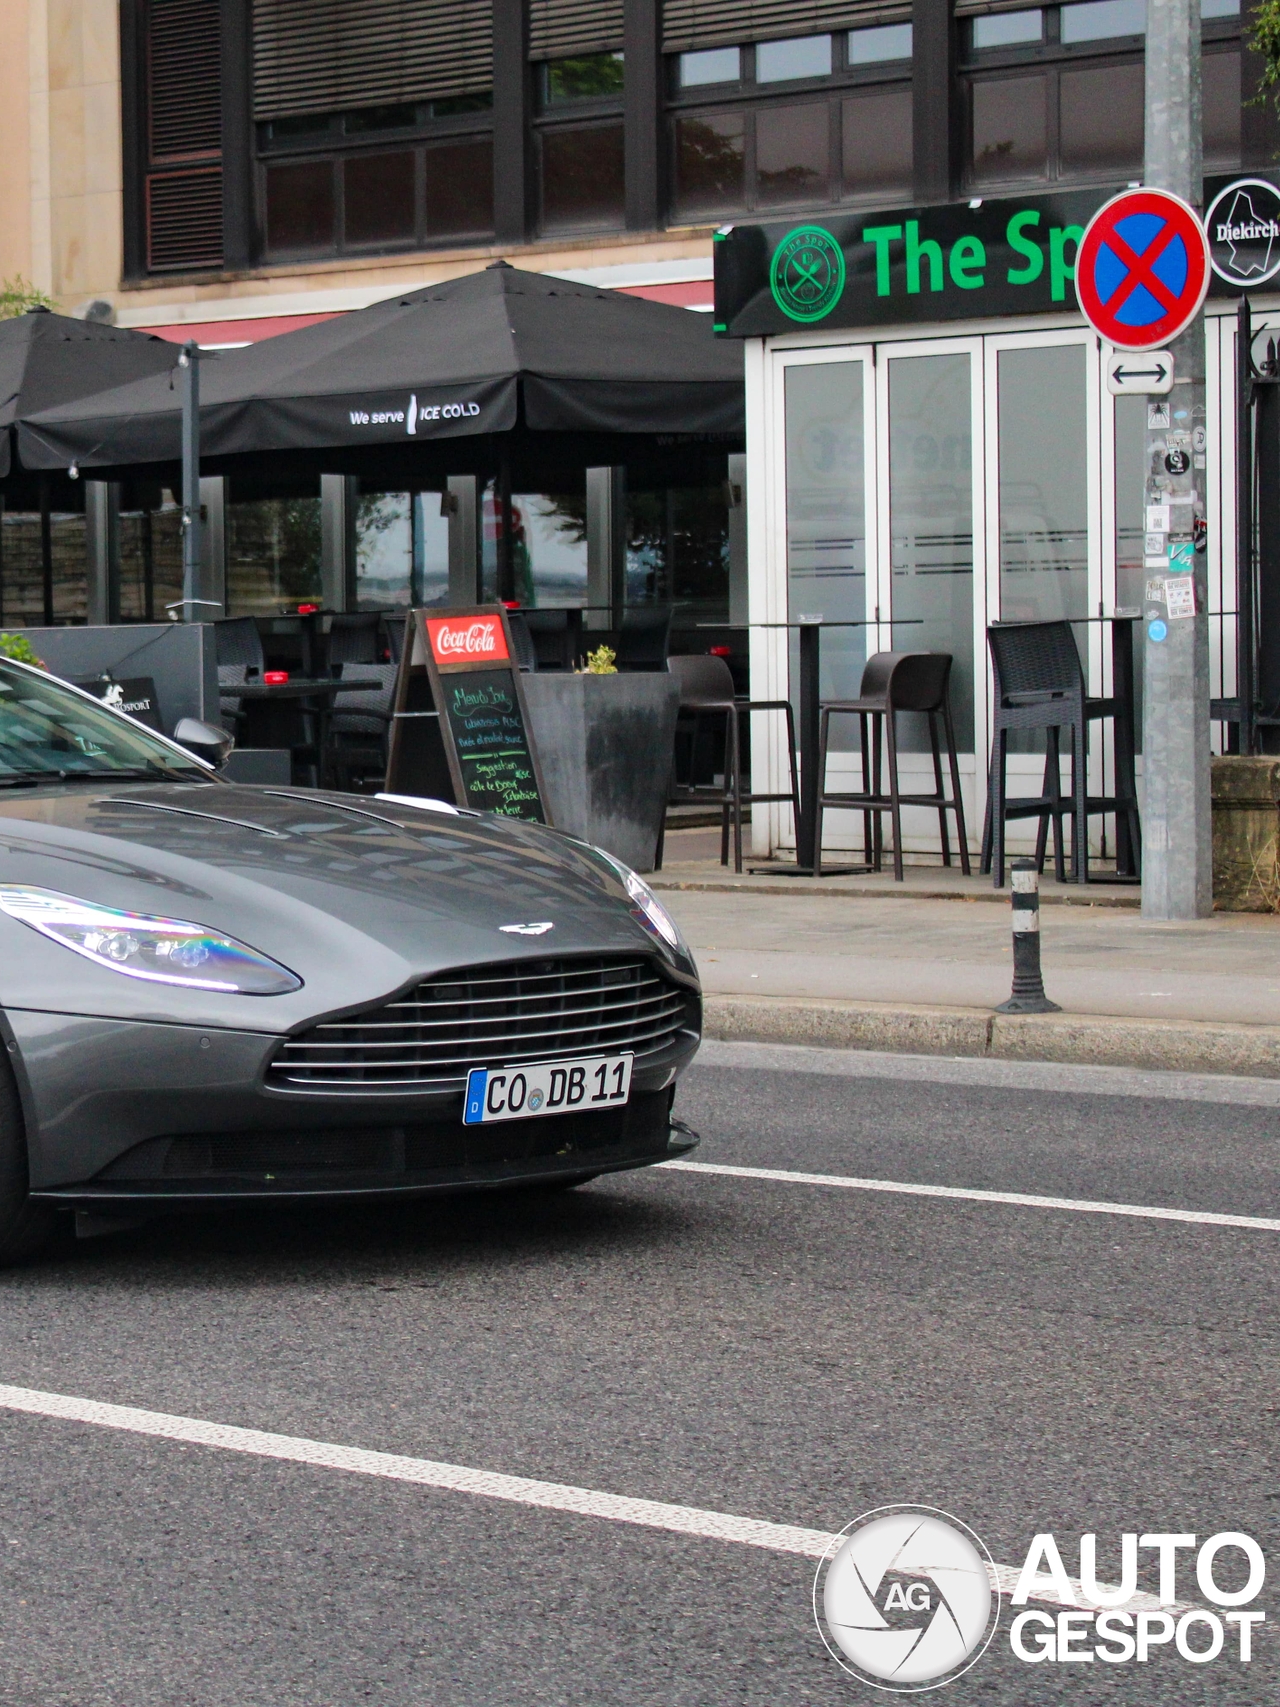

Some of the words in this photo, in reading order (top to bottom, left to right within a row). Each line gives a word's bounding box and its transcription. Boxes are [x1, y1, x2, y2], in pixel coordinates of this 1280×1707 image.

[1216, 219, 1279, 242] Diekirch
[783, 239, 801, 256] The
[862, 219, 986, 297] The
[1006, 209, 1084, 302] Sp
[349, 411, 370, 425] We
[370, 410, 405, 424] serve
[420, 406, 441, 420] ICE
[442, 402, 480, 419] COLD
[437, 623, 495, 655] Coca-Cola
[476, 760, 518, 779] Suggestion
[471, 1102, 479, 1114] D
[487, 1073, 527, 1114] CO
[546, 1066, 586, 1107] DB
[591, 1061, 625, 1102] 11
